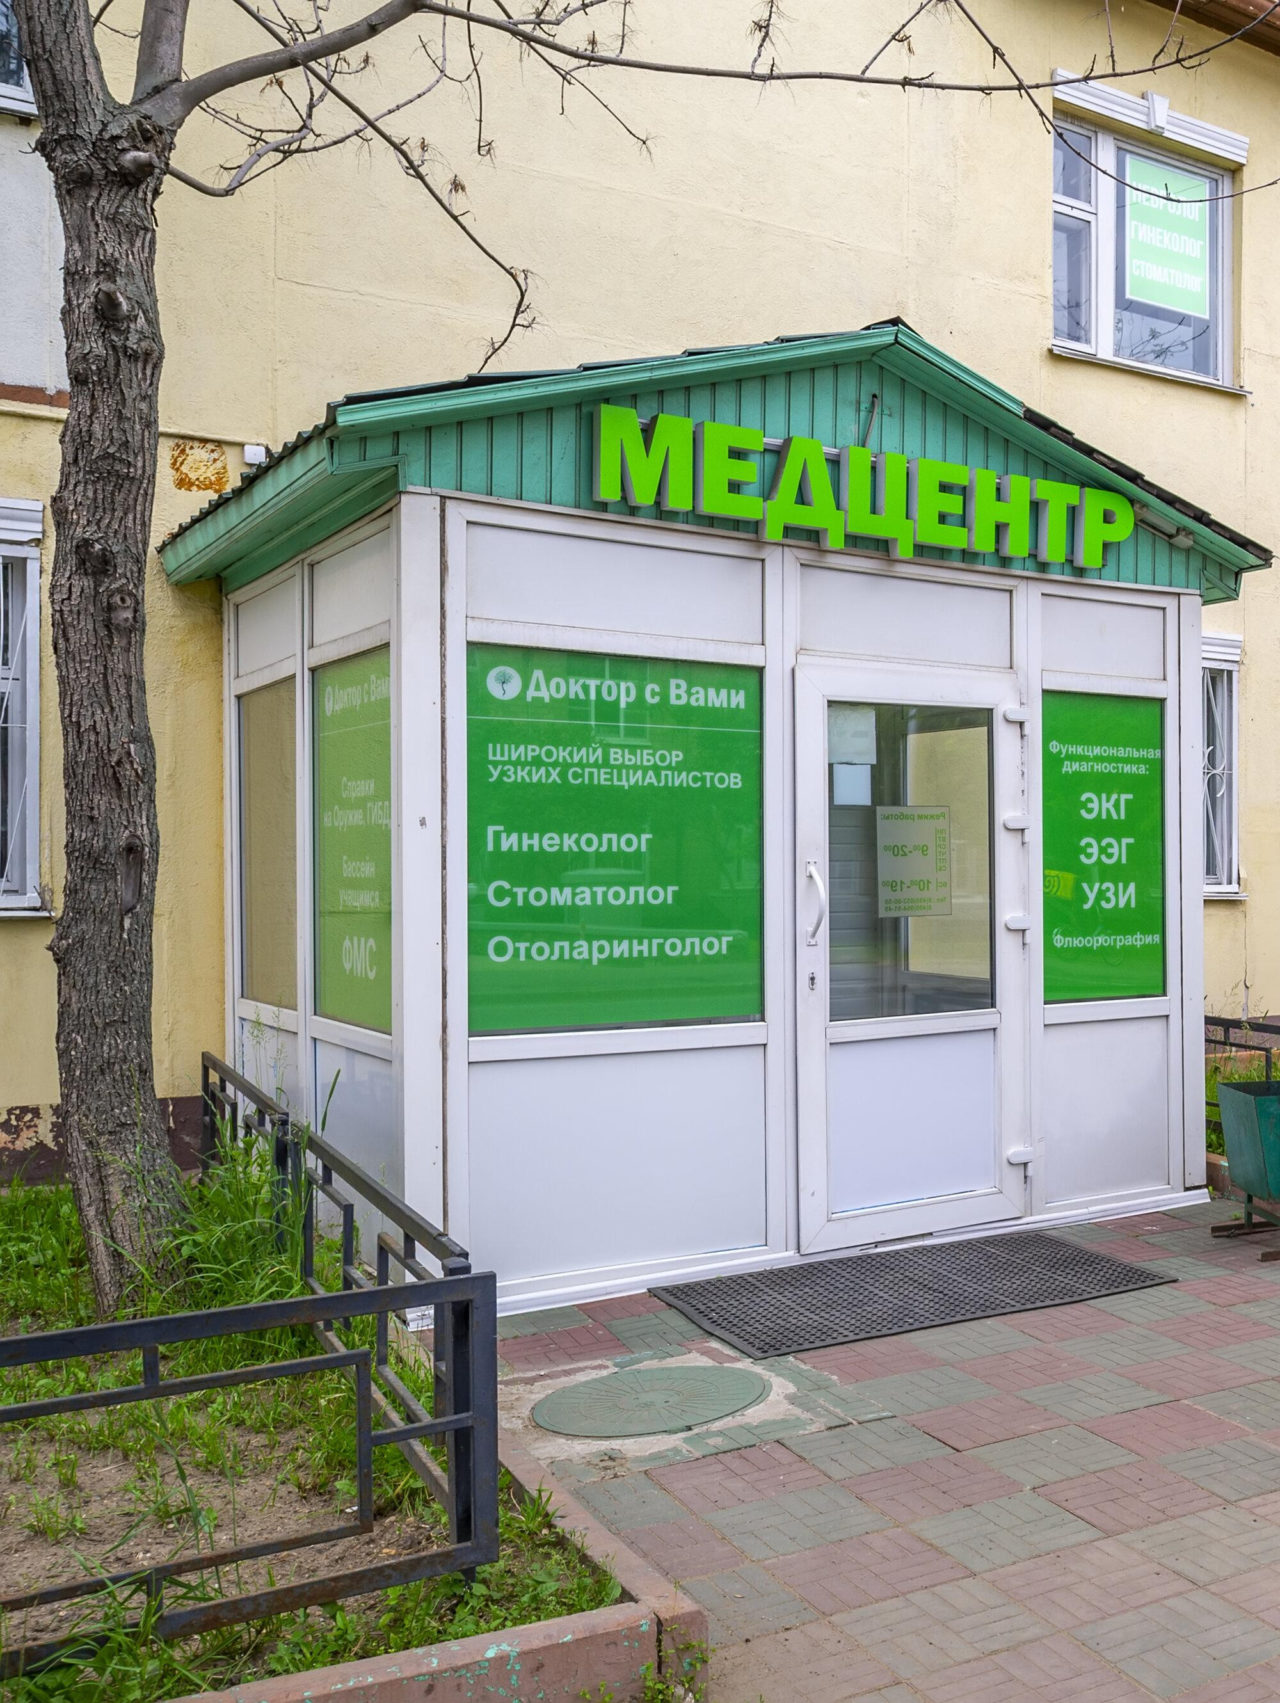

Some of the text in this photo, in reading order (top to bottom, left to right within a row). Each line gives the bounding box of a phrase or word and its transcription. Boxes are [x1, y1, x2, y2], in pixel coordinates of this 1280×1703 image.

[1132, 181, 1202, 222] НЕВРОЛОГ
[1131, 220, 1204, 259] ГИНЕКОЛОГ
[1132, 258, 1203, 293] СТОМАТОЛОГ
[593, 403, 1135, 569] МЕДЦЕНТР
[370, 674, 390, 702] Вам
[526, 669, 746, 709] Доктор с Вами
[487, 743, 684, 767] ШИРОКИЙ ВЫБОР
[1048, 740, 1161, 759] Функциональная
[487, 765, 743, 790] УЗКИХ СПЕЦИАЛИСТОВ
[1061, 760, 1150, 775] диагностика:
[341, 776, 375, 803] Справки
[366, 800, 390, 830] ГИБД
[1079, 792, 1133, 820] ЭКГ
[486, 825, 653, 852] Гинеколог
[1079, 837, 1135, 865] ЭЭГ
[342, 856, 376, 879] Бассейн
[487, 880, 679, 907] Стоматолог
[1082, 881, 1136, 910] УЗИ
[487, 935, 734, 965] Отоларинголог
[1053, 931, 1160, 950] Флюорография
[342, 936, 377, 980] ФМС
